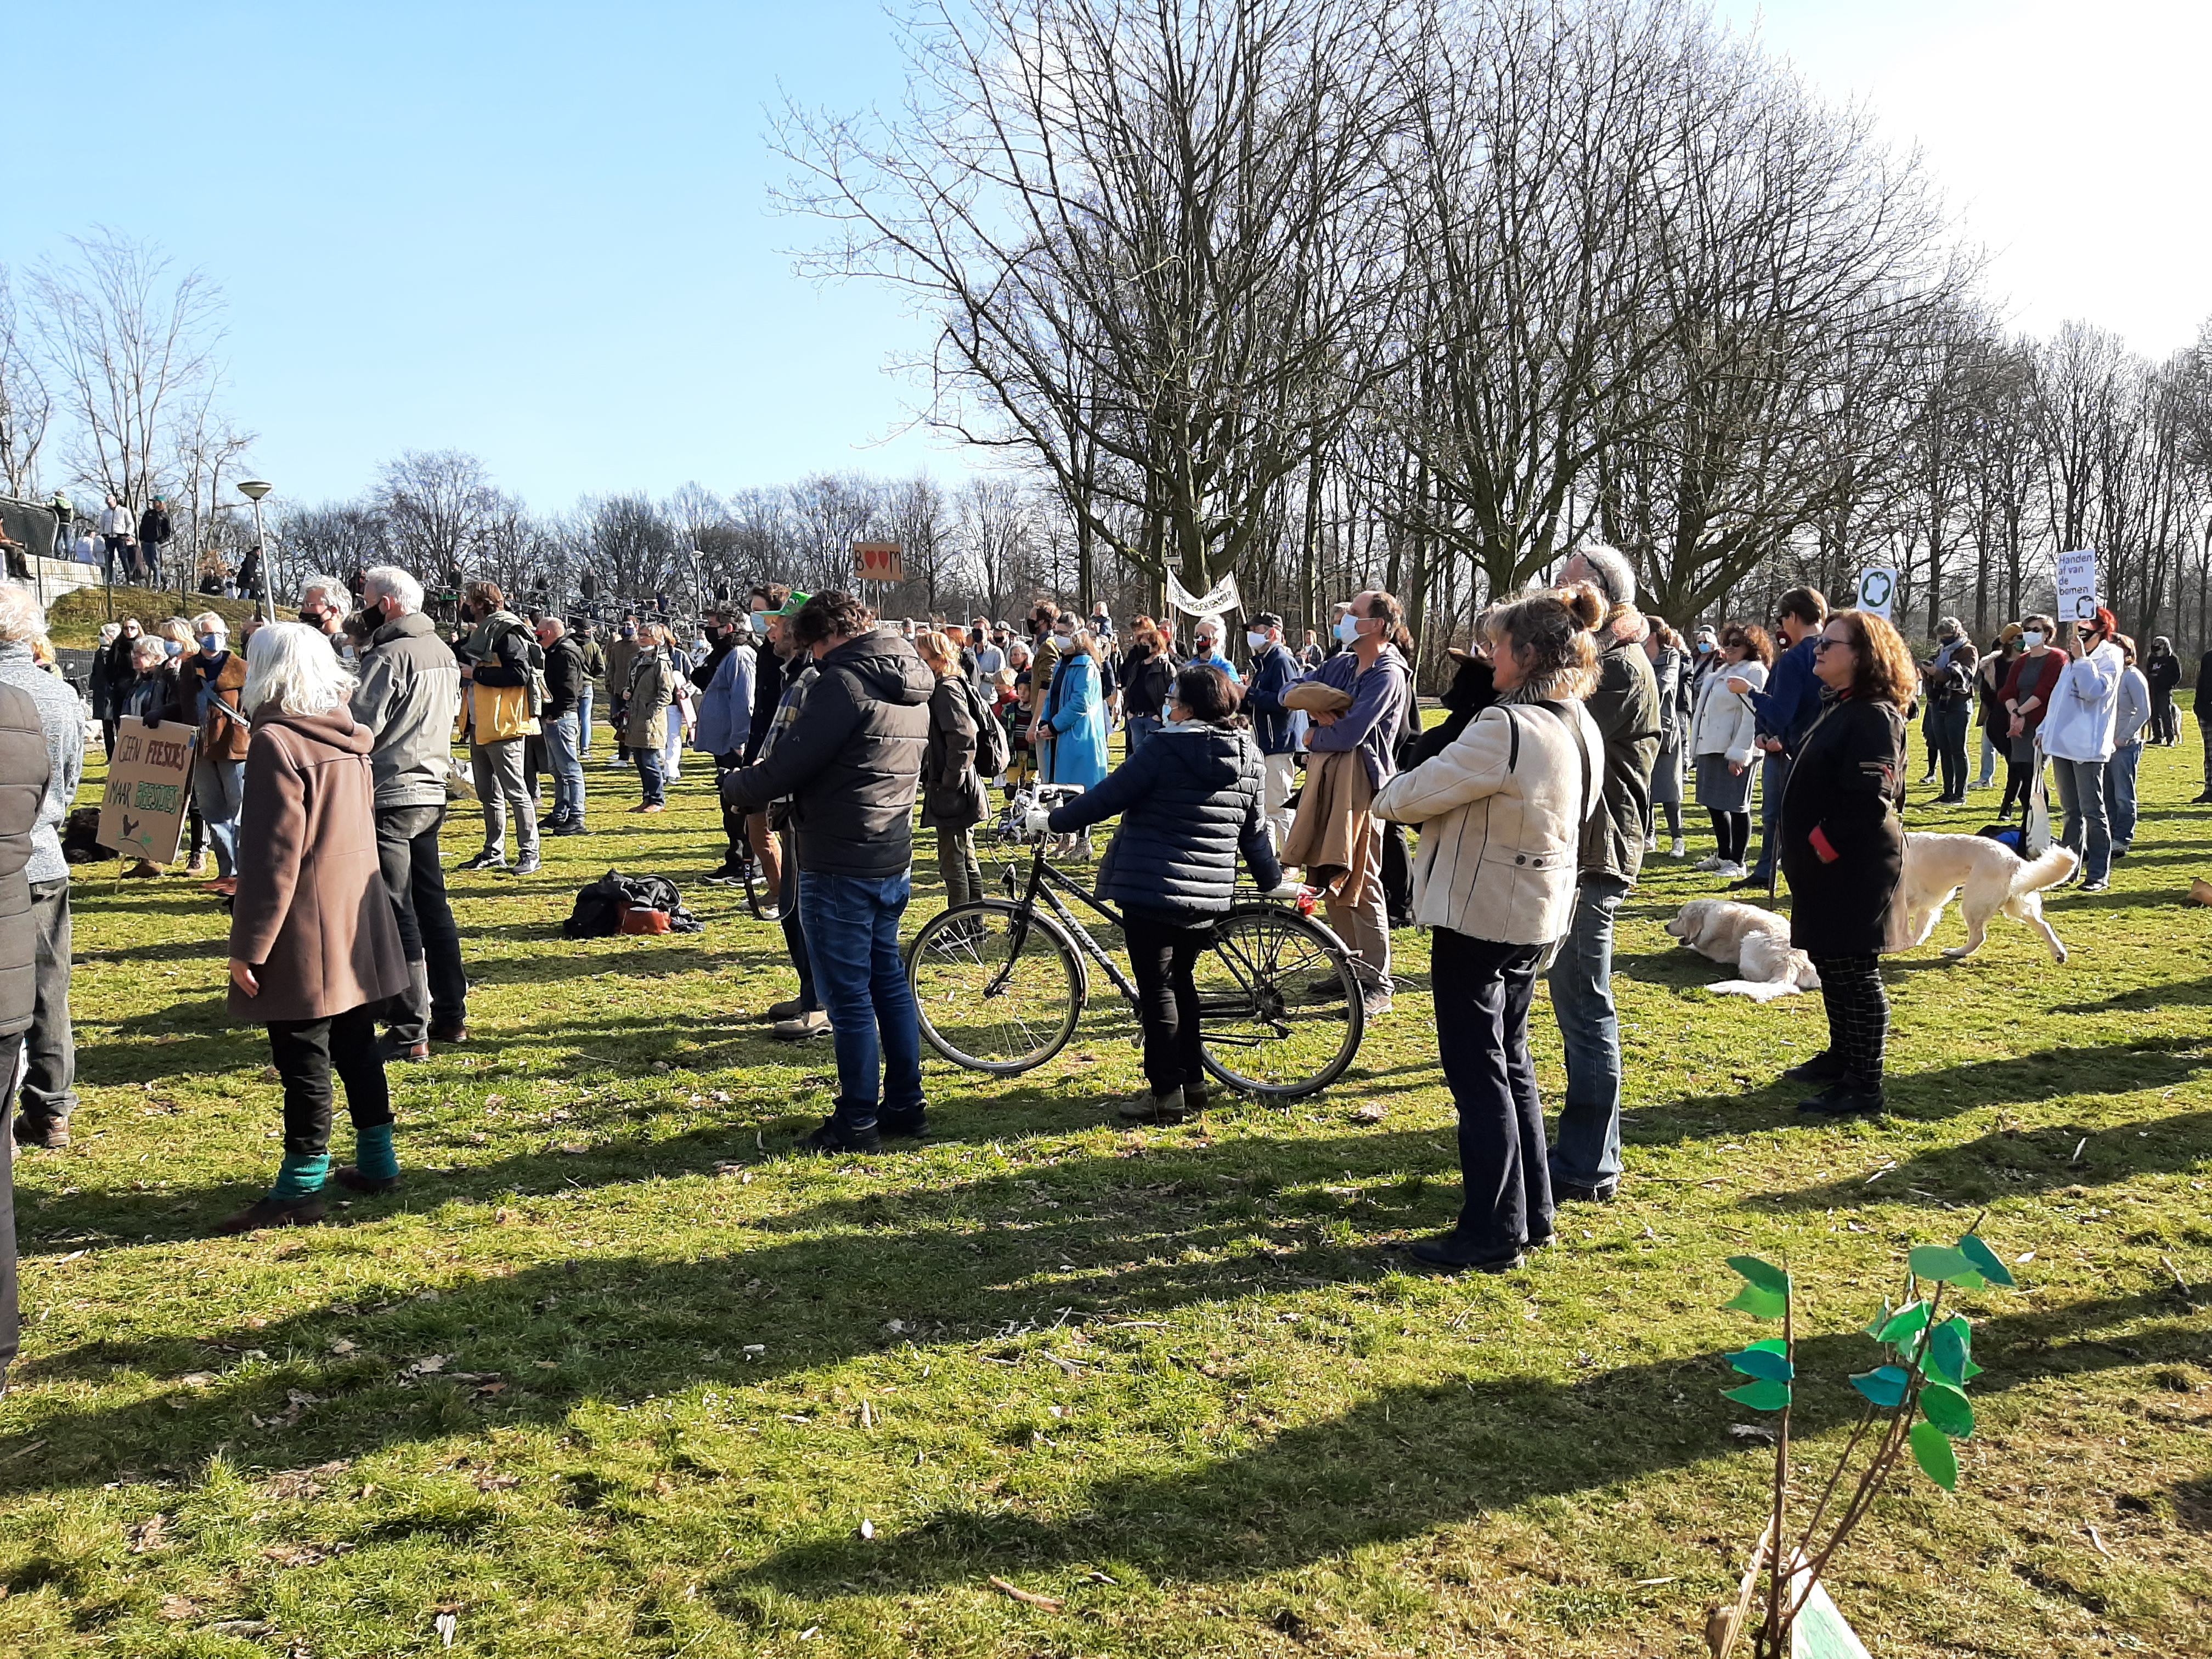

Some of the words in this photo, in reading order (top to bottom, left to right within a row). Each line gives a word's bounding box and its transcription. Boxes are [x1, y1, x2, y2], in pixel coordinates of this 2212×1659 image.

[2058, 554, 2092, 565] Handen
[2058, 565, 2066, 575] af
[2068, 566, 2084, 574] van
[2058, 577, 2069, 585] de
[118, 734, 143, 763] GEEN
[145, 740, 187, 771] FEESTJES
[109, 778, 132, 808] MAAR
[134, 781, 179, 815] BEESTJES
[1057, 907, 1110, 966] BATAVUS
